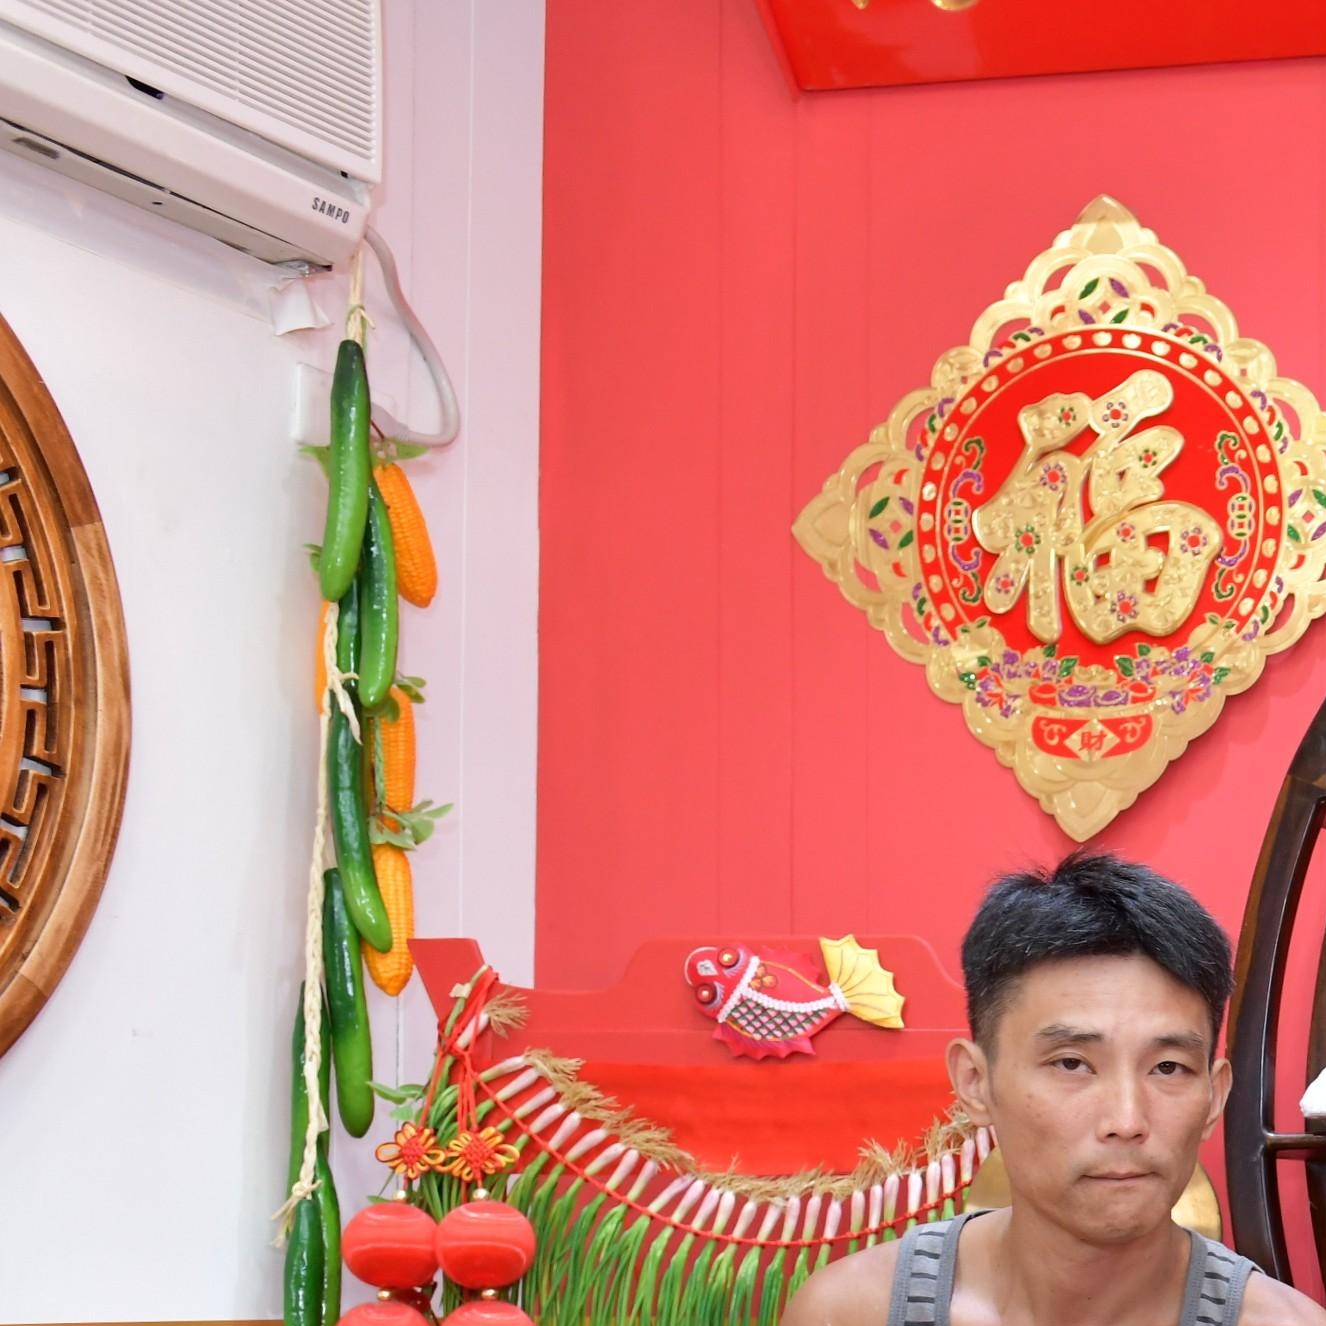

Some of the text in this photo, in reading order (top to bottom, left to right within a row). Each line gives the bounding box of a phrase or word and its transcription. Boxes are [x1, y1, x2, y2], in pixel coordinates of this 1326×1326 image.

[312, 197, 350, 224] SAMPO
[971, 369, 1222, 644] 福
[1078, 730, 1107, 752] 財
